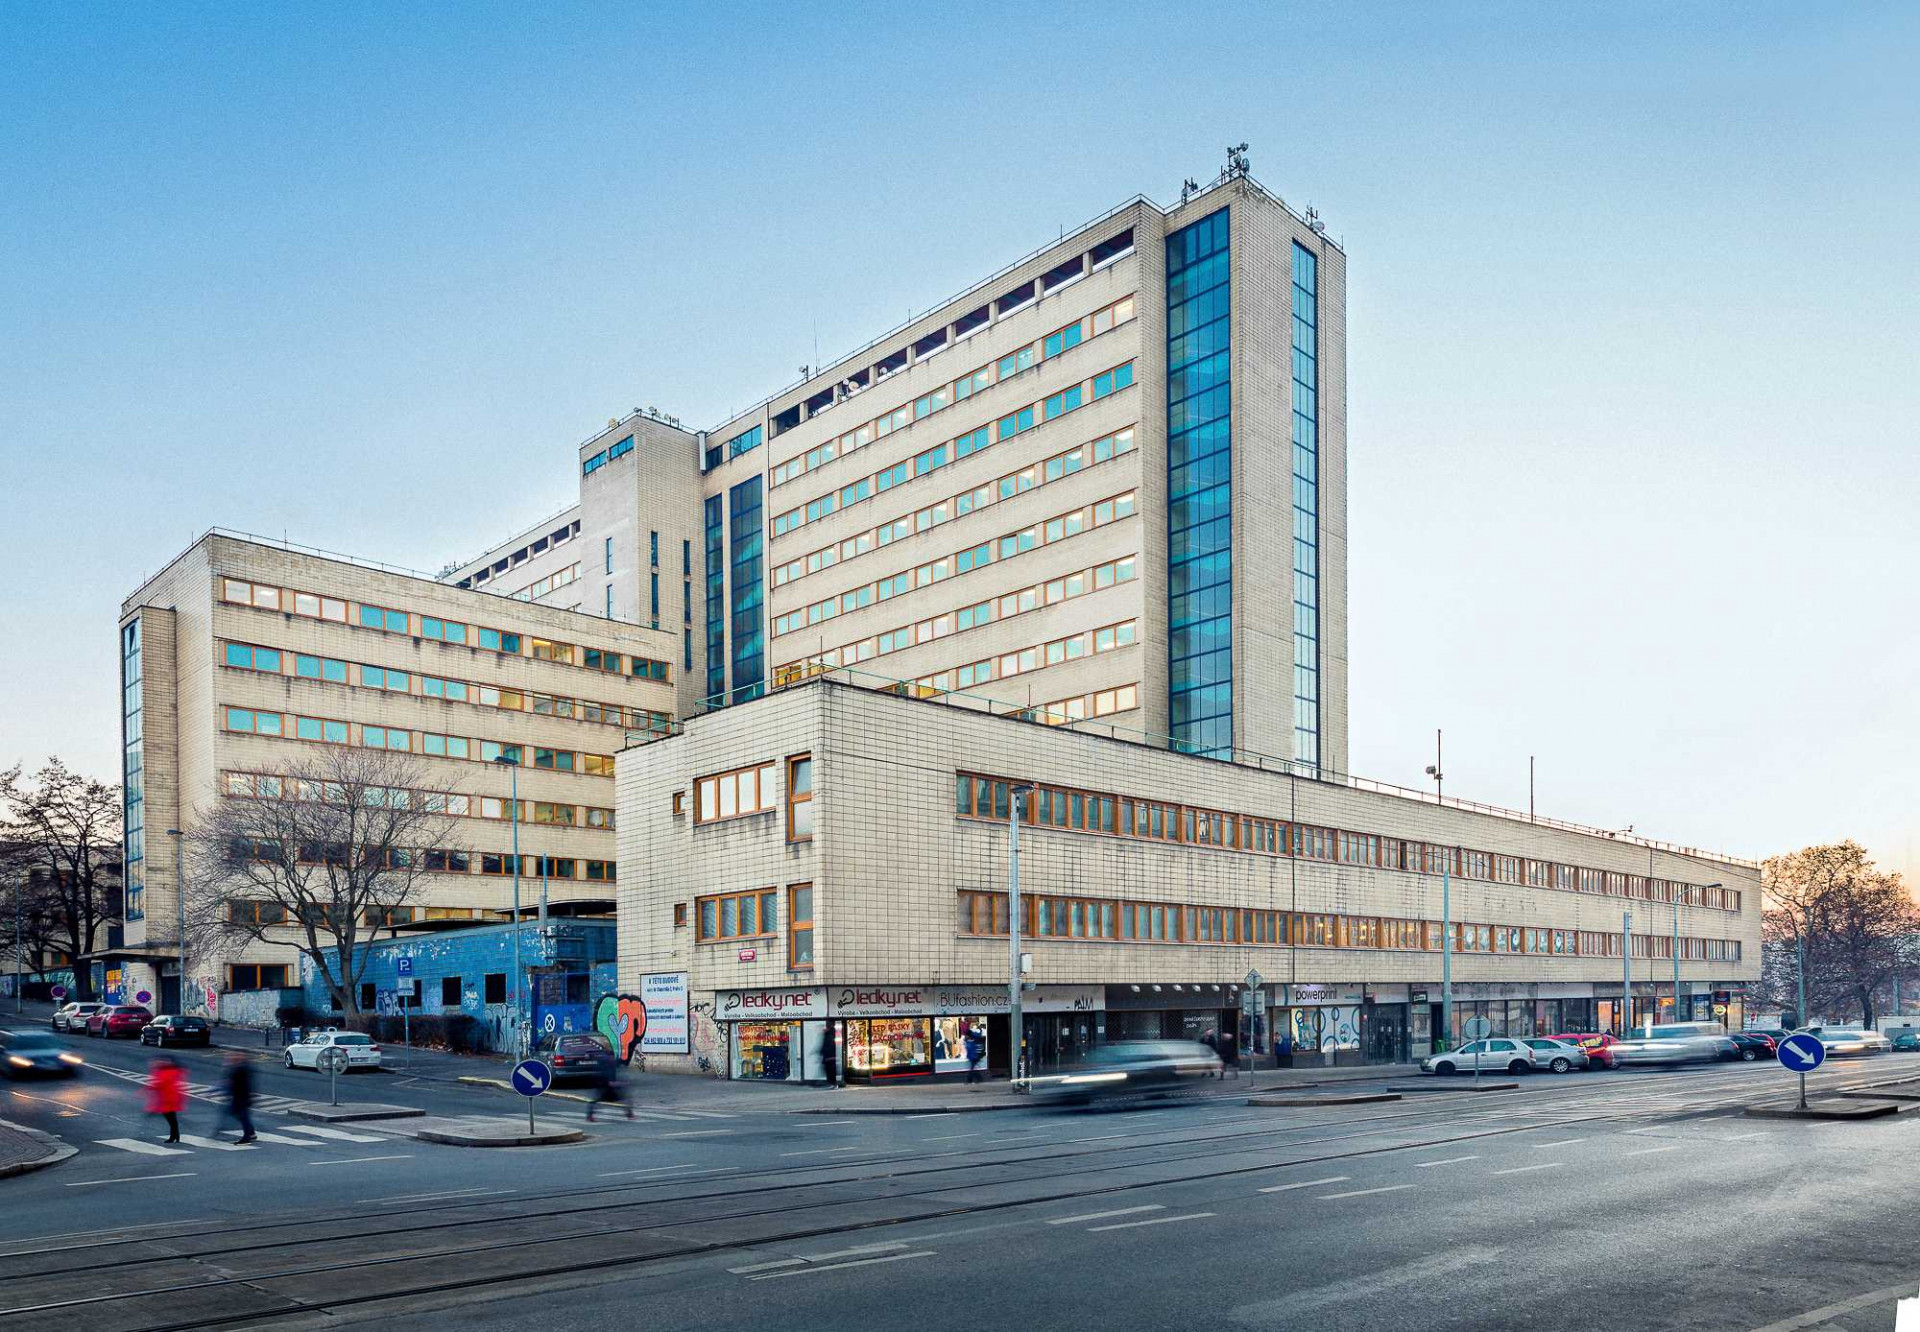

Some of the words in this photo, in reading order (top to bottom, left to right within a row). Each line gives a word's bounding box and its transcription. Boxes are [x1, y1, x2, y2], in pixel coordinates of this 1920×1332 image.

[742, 992, 812, 1010] ledky.net
[857, 989, 922, 1008] ledky.net
[941, 993, 1008, 1007] BUfashion.cz
[1295, 988, 1338, 1002] powerprint
